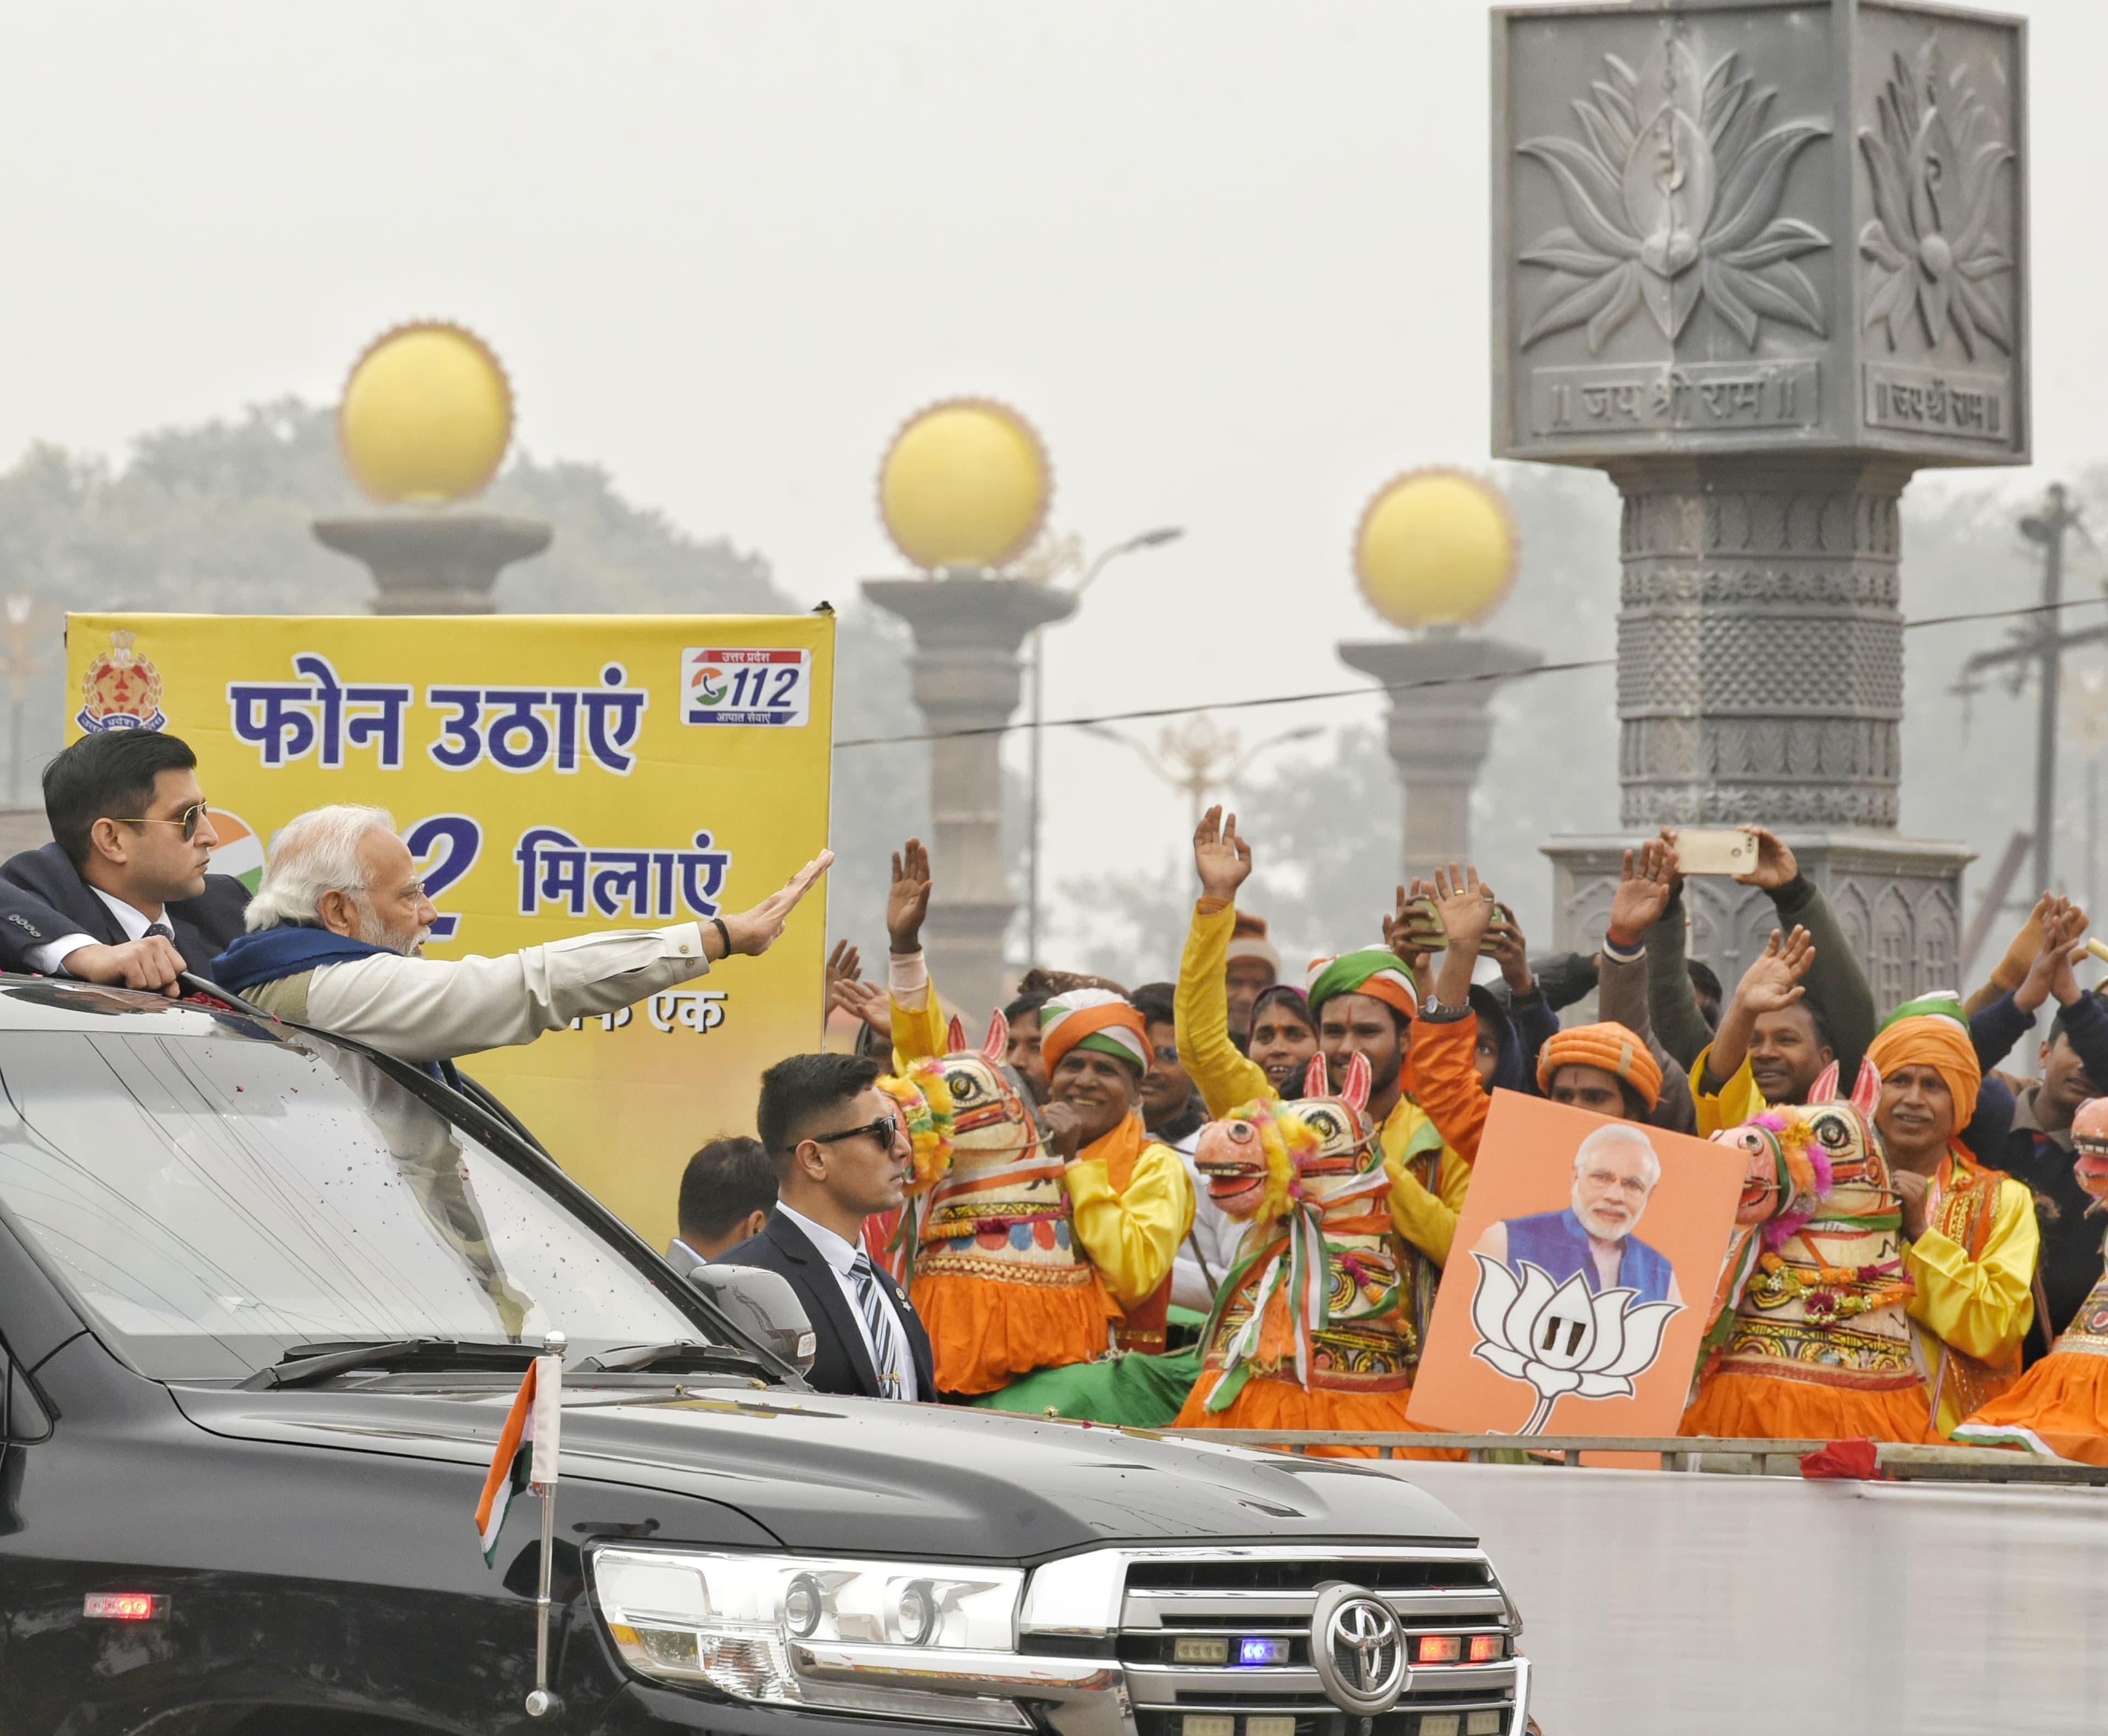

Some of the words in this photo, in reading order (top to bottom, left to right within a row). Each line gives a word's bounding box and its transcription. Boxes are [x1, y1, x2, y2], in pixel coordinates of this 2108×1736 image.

[1582, 381, 1645, 422] जय
[1653, 371, 1693, 423] श्री
[1700, 376, 1764, 419] राम
[721, 651, 745, 662] उत्तर
[746, 650, 771, 663] प्रदेश
[731, 667, 800, 707] 112
[228, 654, 412, 768] फोन
[428, 664, 647, 774] उठाएं
[716, 712, 744, 724] आपात
[514, 827, 730, 918] मिलाएं
[647, 989, 728, 1034] एक
